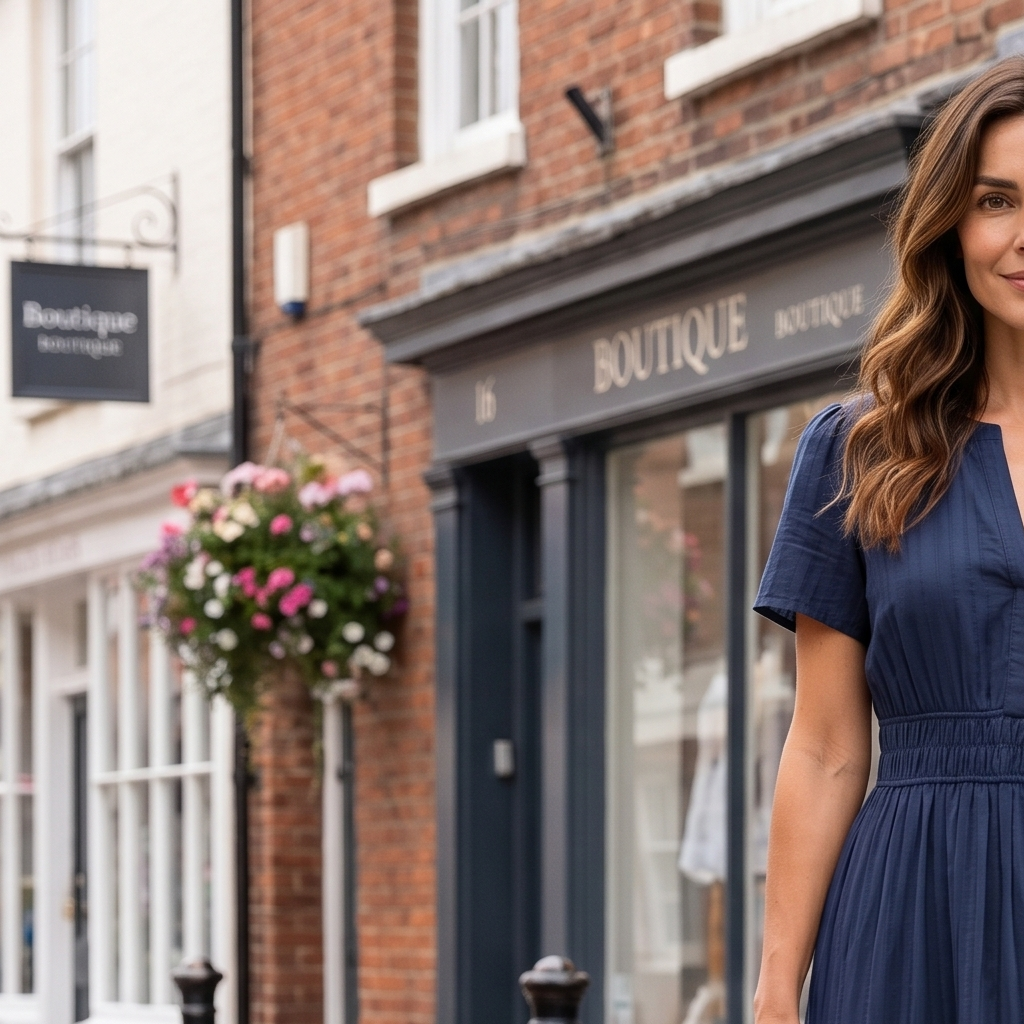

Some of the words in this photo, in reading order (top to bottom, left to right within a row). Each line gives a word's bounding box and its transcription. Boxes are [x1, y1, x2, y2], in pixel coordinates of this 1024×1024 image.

[22, 300, 139, 339] Boutique
[592, 292, 750, 394] BOUTIQUE
[774, 283, 865, 340] BOUTIQUE
